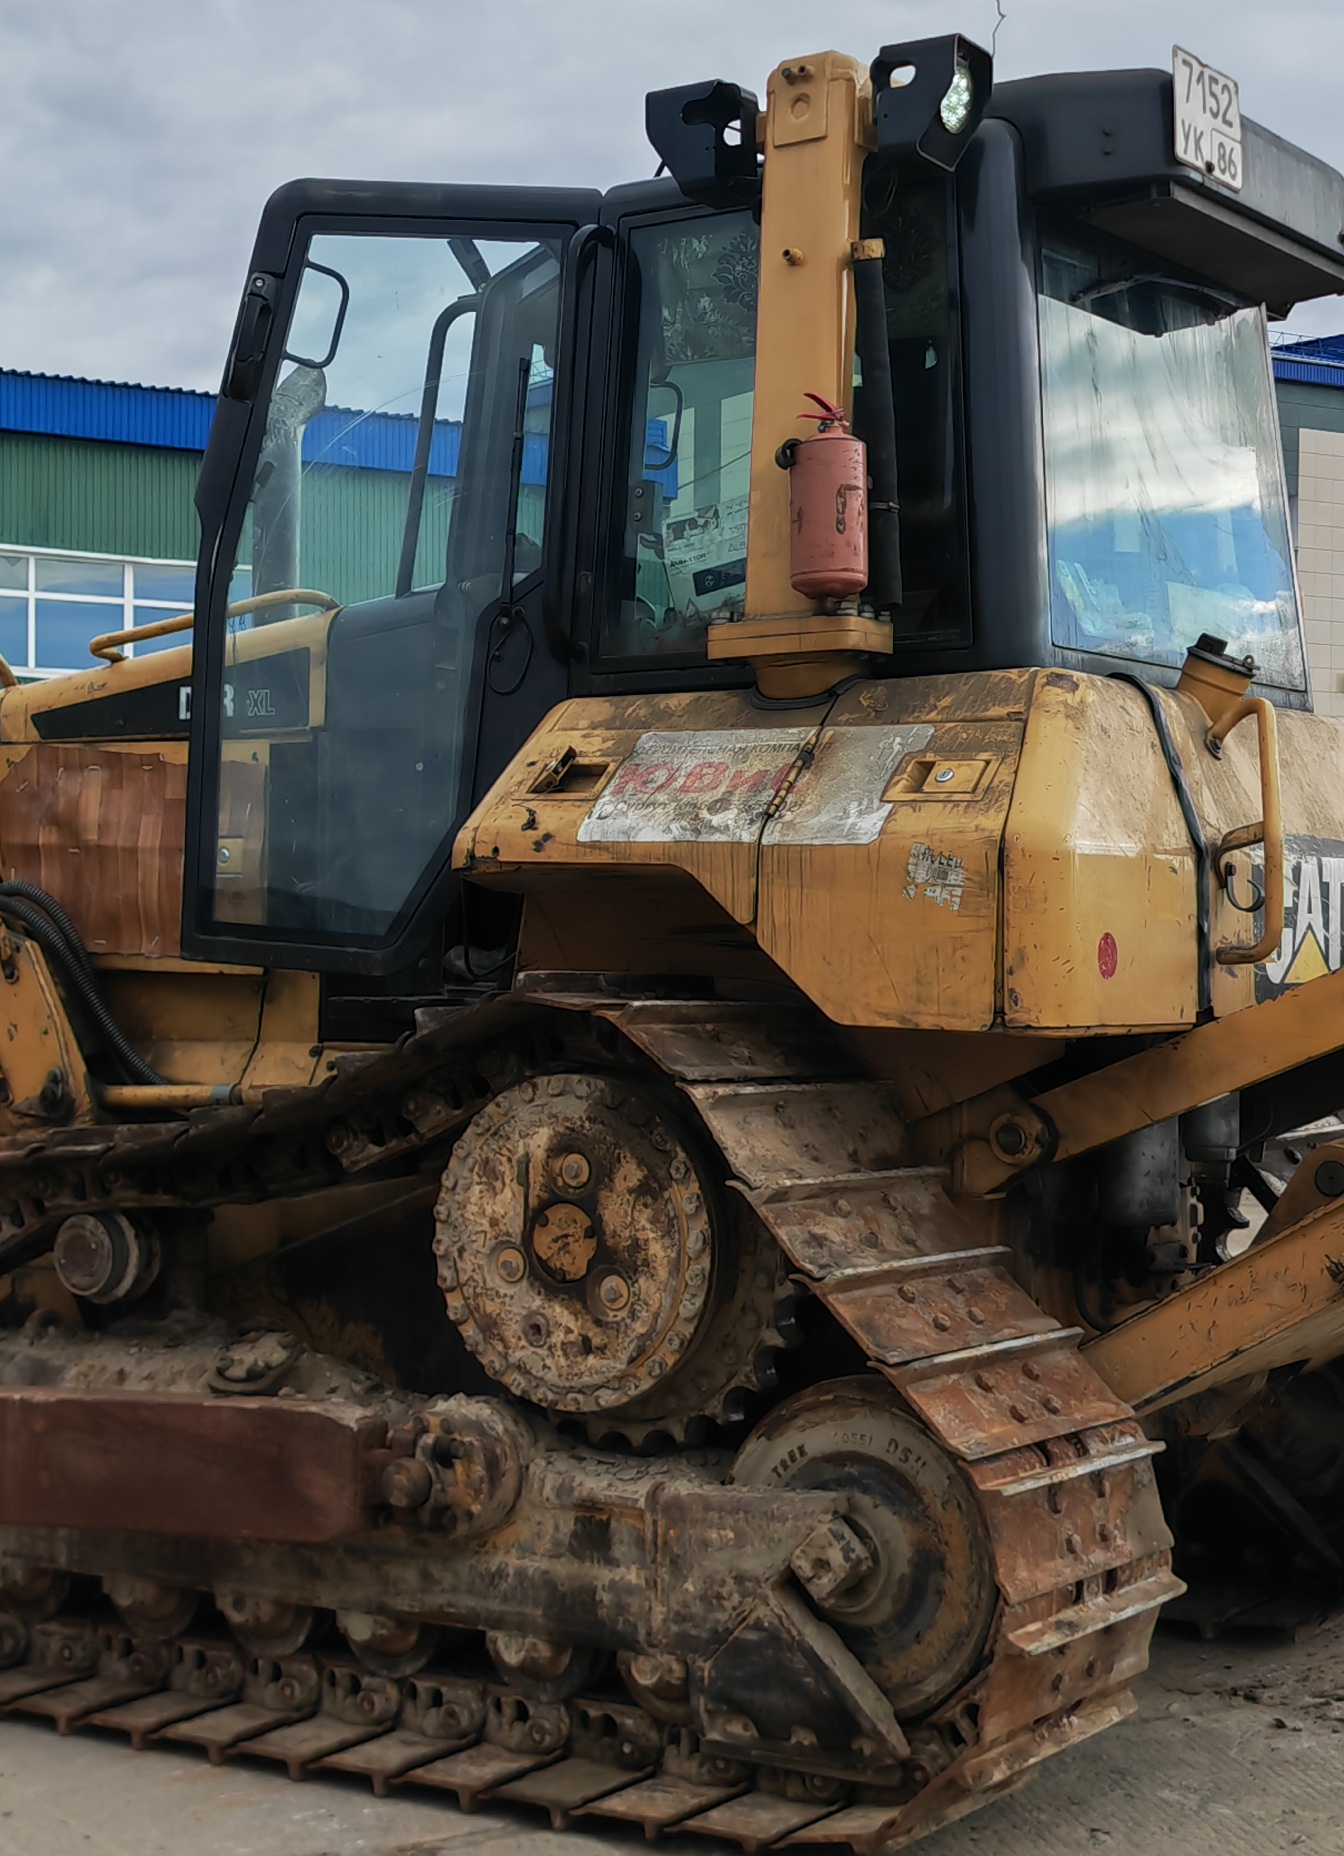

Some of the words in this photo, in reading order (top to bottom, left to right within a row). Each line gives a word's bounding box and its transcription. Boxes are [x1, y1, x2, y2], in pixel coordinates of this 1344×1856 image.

[1181, 58, 1234, 129] 7152
[1217, 141, 1238, 181] 86
[247, 689, 276, 716] XL
